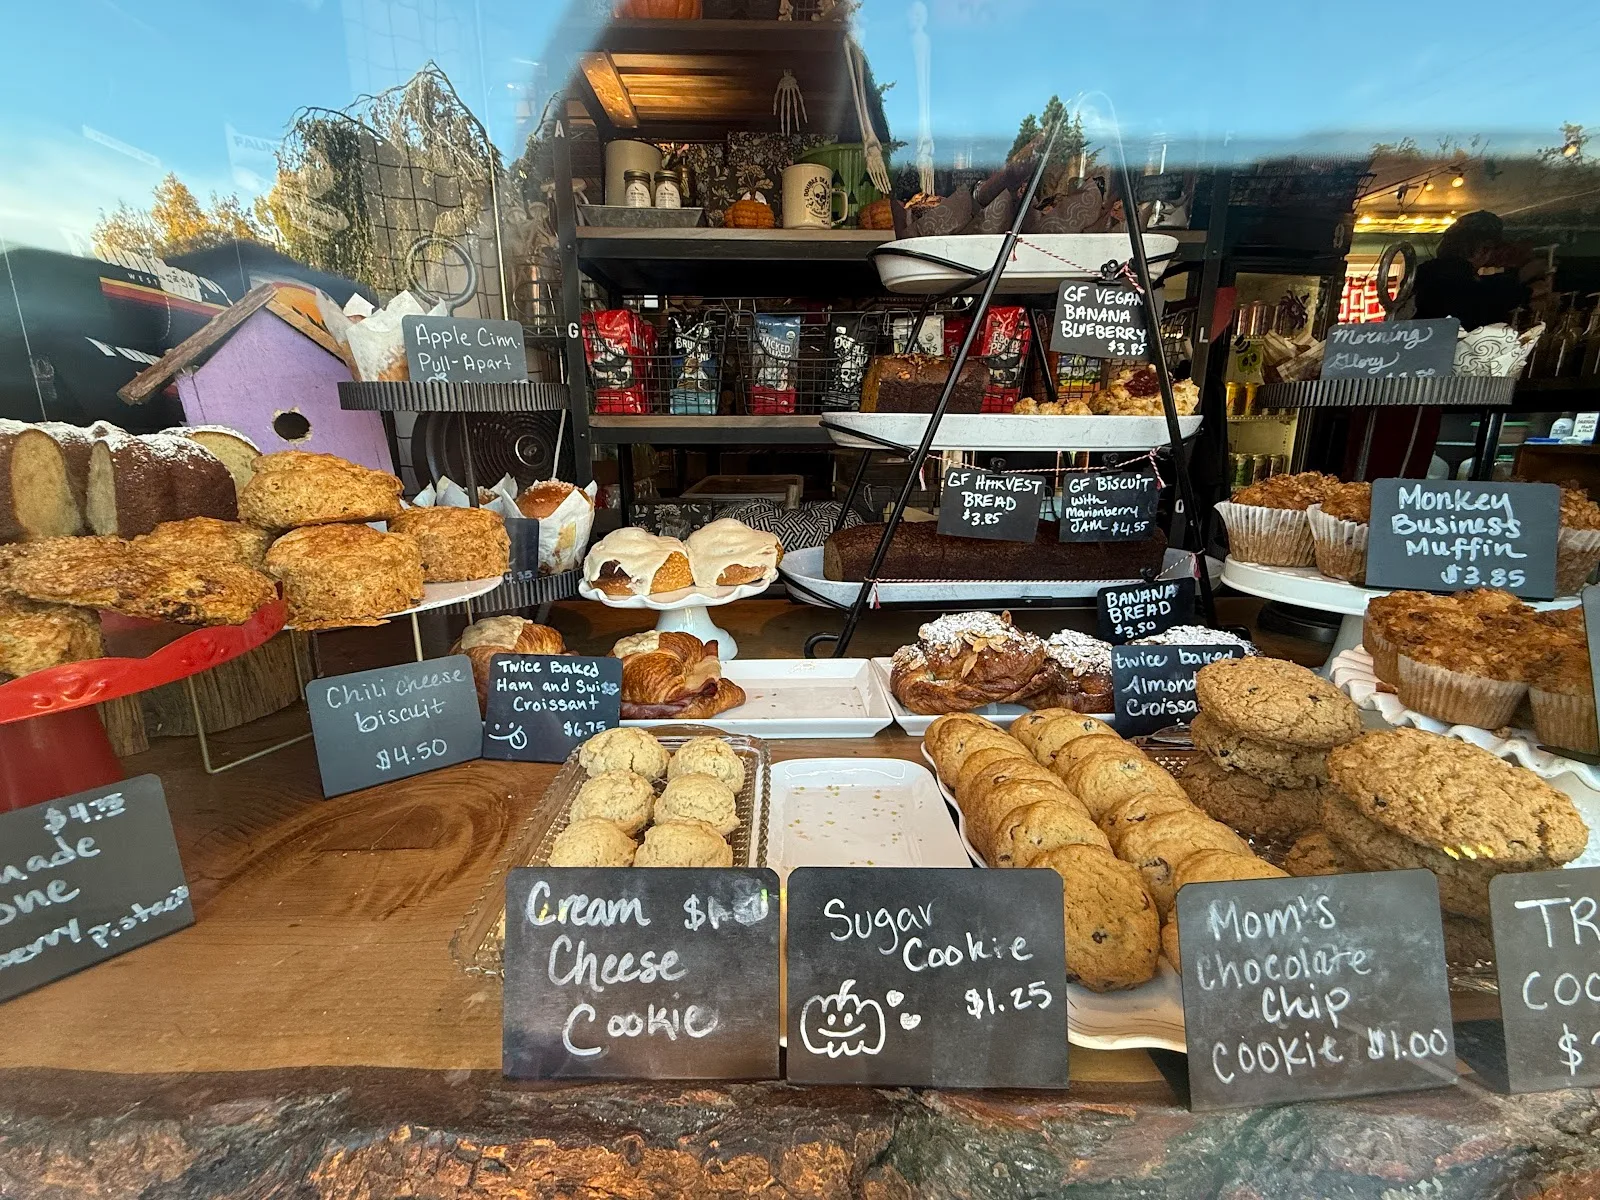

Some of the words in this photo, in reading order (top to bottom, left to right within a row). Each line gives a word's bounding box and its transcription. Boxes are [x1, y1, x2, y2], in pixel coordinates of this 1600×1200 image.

[1063, 285, 1090, 303] GF
[1095, 288, 1144, 307] VEGAN
[1063, 303, 1131, 323] BANANA
[415, 323, 472, 350] Apple
[567, 322, 579, 339] G
[1060, 320, 1147, 343] BLUEBERRY
[1332, 323, 1434, 350] Morning
[1107, 340, 1148, 356] $3.85
[417, 352, 512, 373] Pull-Apart
[1328, 351, 1400, 375] Glory
[947, 471, 971, 487] GF
[975, 474, 1043, 495] HARVEST
[1069, 478, 1091, 493] GF
[960, 491, 1017, 511] BREAD
[1071, 493, 1107, 506] with
[1398, 483, 1514, 523] Monkey
[962, 508, 1003, 526] $3.85
[1065, 506, 1139, 519] Marionberry
[1069, 518, 1108, 533] JAM
[1111, 520, 1149, 536] $4.55
[1391, 513, 1522, 539] Business
[1405, 537, 1528, 562] Muffin
[1440, 563, 1526, 588] $3.85
[1105, 582, 1180, 609] BANANA
[1107, 600, 1172, 624] BREAD
[1114, 620, 1157, 639] $3.50
[497, 660, 542, 673] Twice
[550, 661, 600, 678] Baked
[1114, 651, 1169, 669] twice
[326, 678, 387, 709] Chili
[496, 677, 534, 692] Ham
[542, 677, 570, 692] and
[1121, 670, 1198, 695] Almond
[513, 693, 600, 712] Croissant
[1126, 697, 1201, 717] Croissa
[354, 698, 447, 733] biscuit
[563, 720, 607, 738] $6.75
[375, 738, 448, 771] $4.50
[526, 880, 651, 927] Cream
[823, 897, 936, 955] Sugar
[1206, 894, 1336, 943] Mom's
[548, 934, 689, 993] Cheese
[901, 932, 1034, 972] Cookie
[964, 980, 1052, 1020] $1.25
[562, 991, 719, 1057] Cookie
[1367, 1026, 1448, 1060] $1.00
